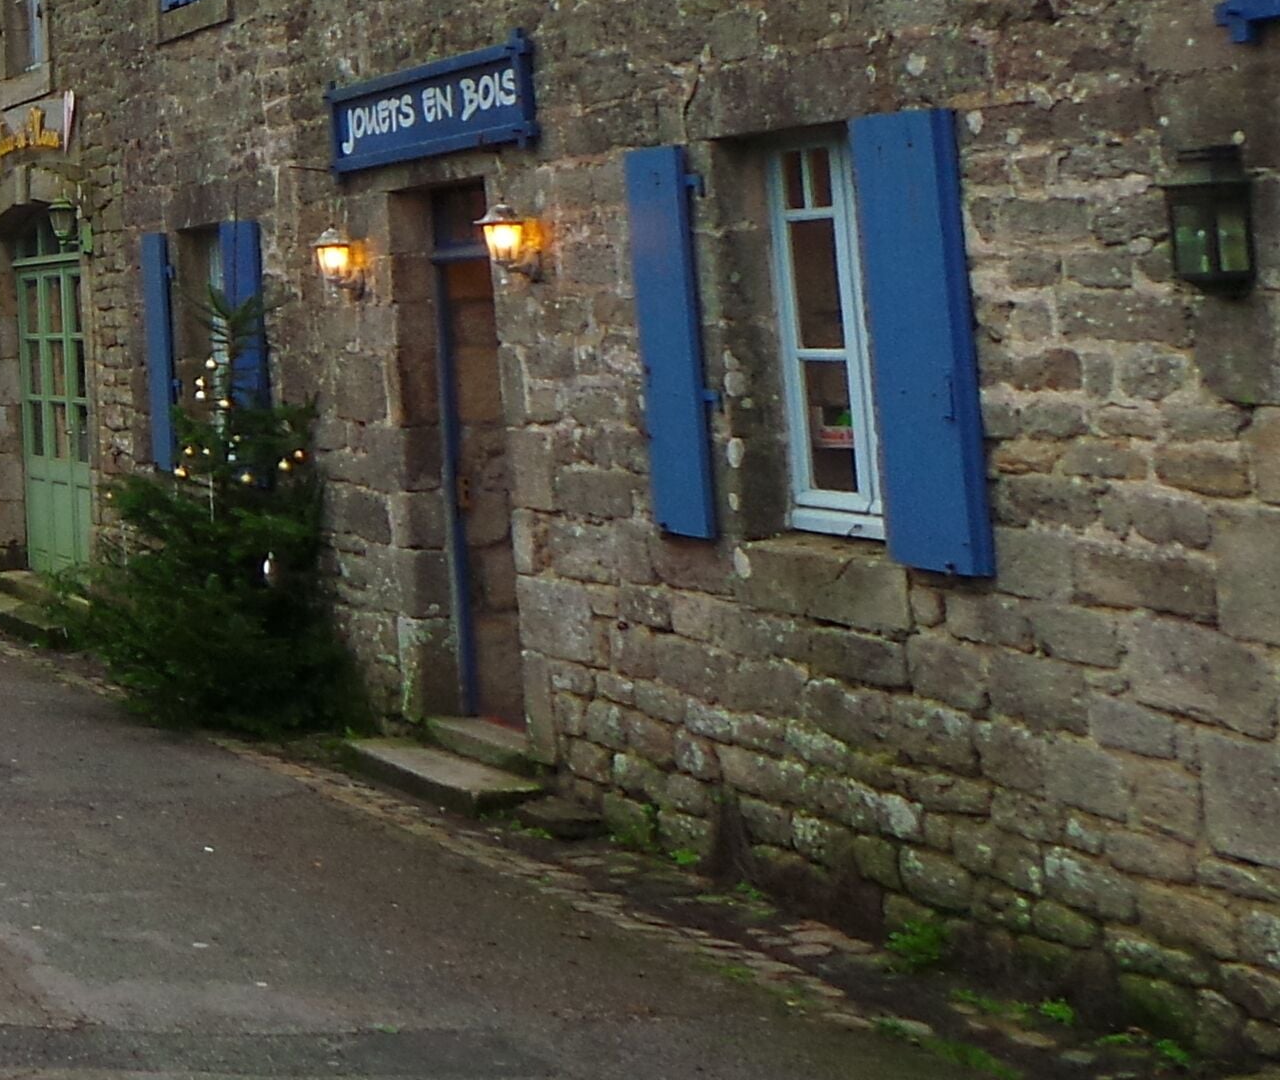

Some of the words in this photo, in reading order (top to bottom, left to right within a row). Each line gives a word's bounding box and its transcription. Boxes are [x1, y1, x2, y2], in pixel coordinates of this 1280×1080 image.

[342, 94, 416, 155] JOUETS
[421, 84, 453, 123] EN
[459, 68, 517, 122] BOIS
